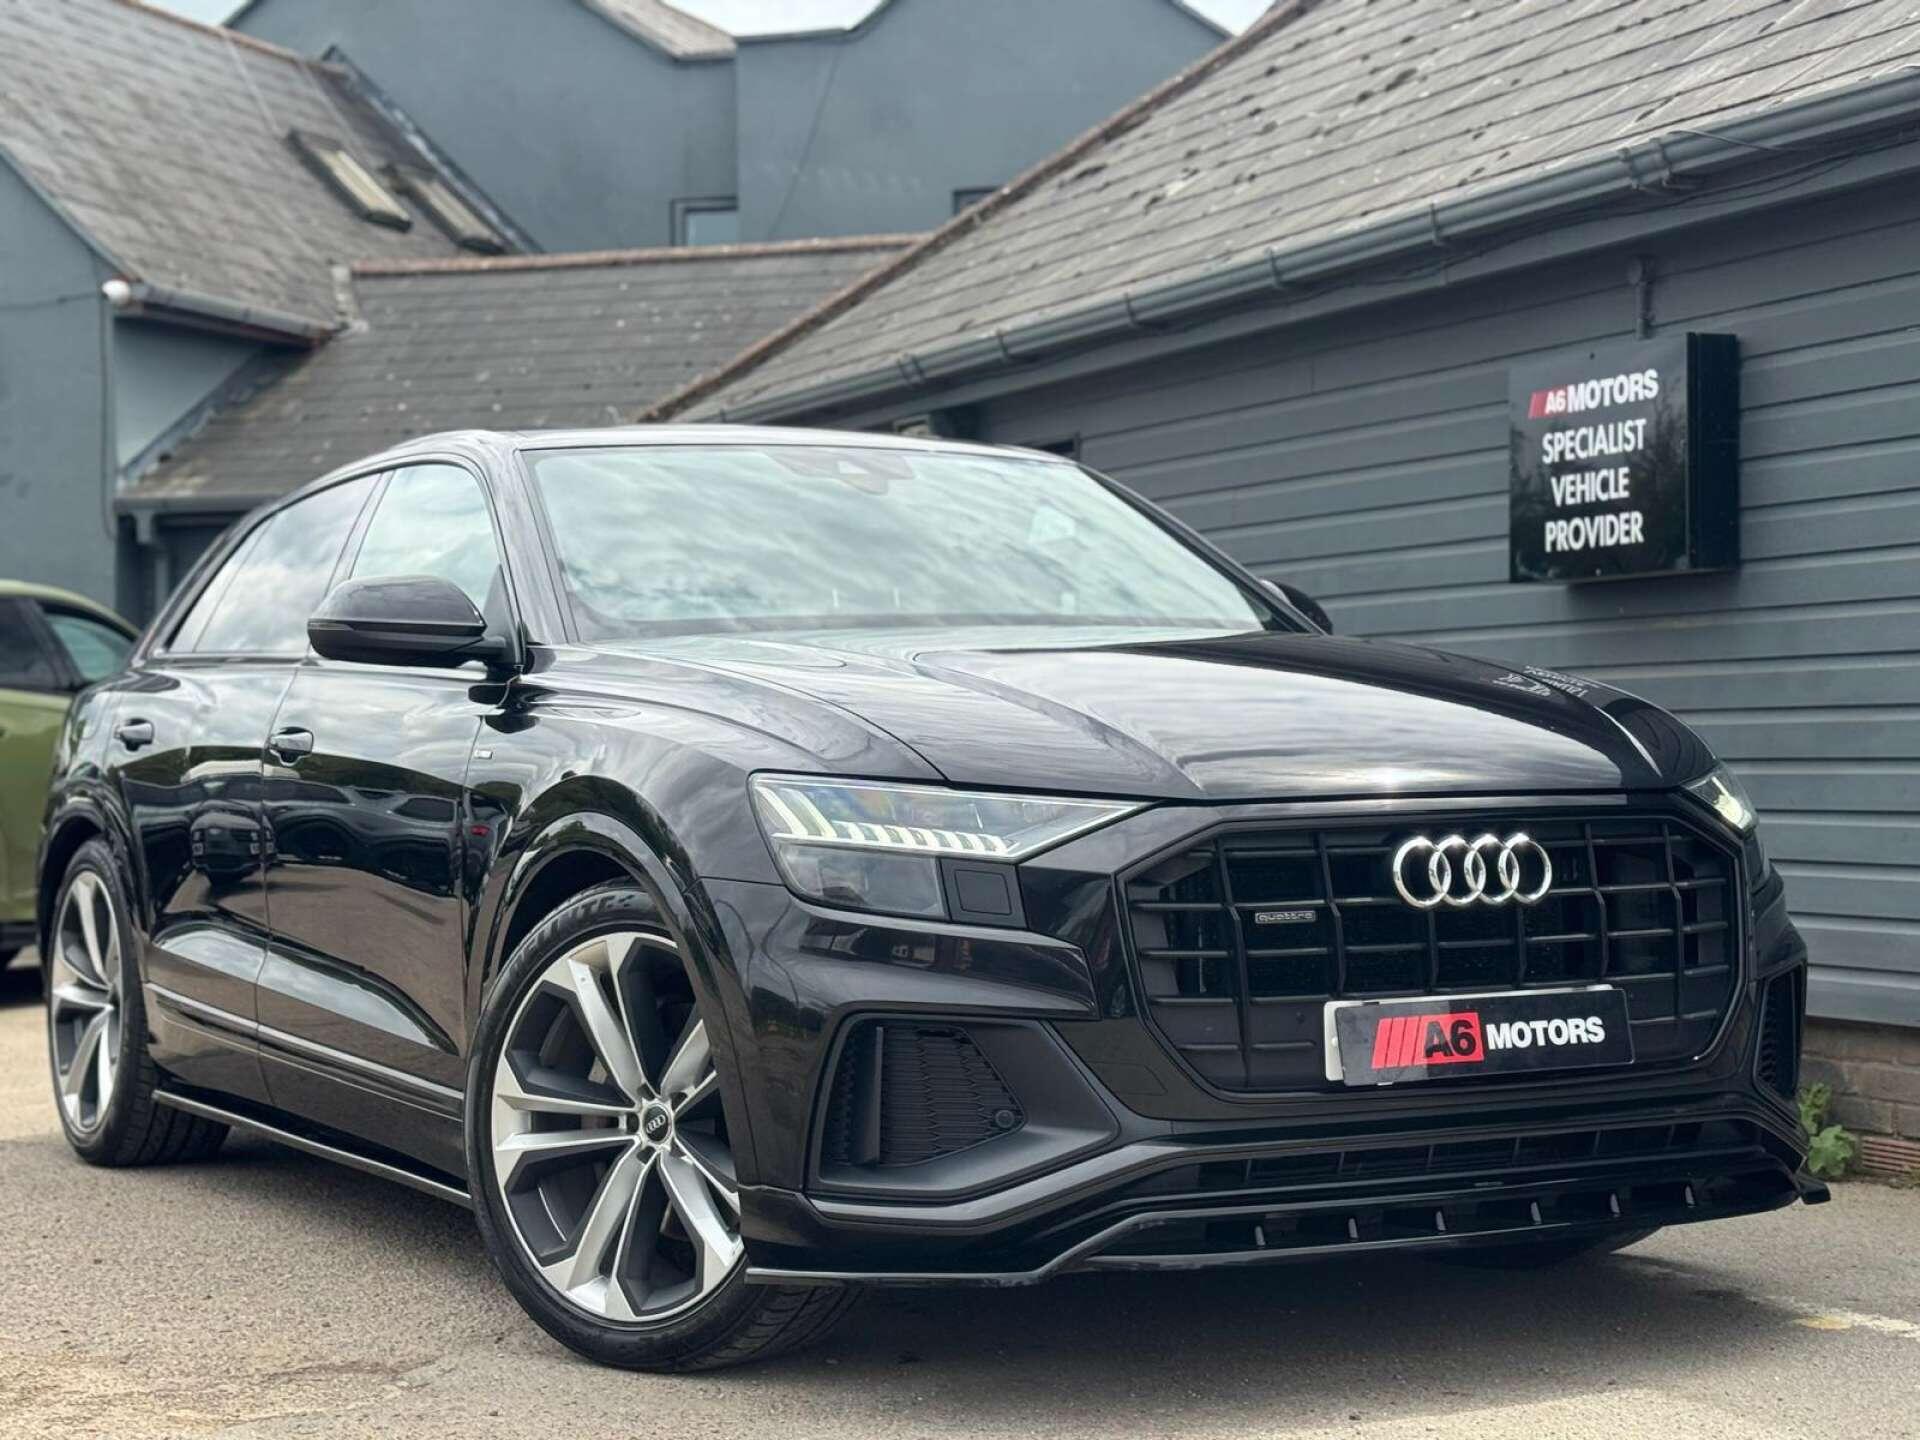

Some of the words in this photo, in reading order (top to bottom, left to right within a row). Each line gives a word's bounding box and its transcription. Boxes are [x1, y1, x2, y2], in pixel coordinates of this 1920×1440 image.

[1545, 390, 1567, 415] A6
[1567, 368, 1659, 413] MOTORS
[1541, 418, 1647, 464] SPECIALIST
[1551, 466, 1630, 507] VEHICLE
[1544, 511, 1644, 553] PROVIDER
[1423, 1019, 1477, 1058] A6
[1486, 1015, 1606, 1050] MOTORS
